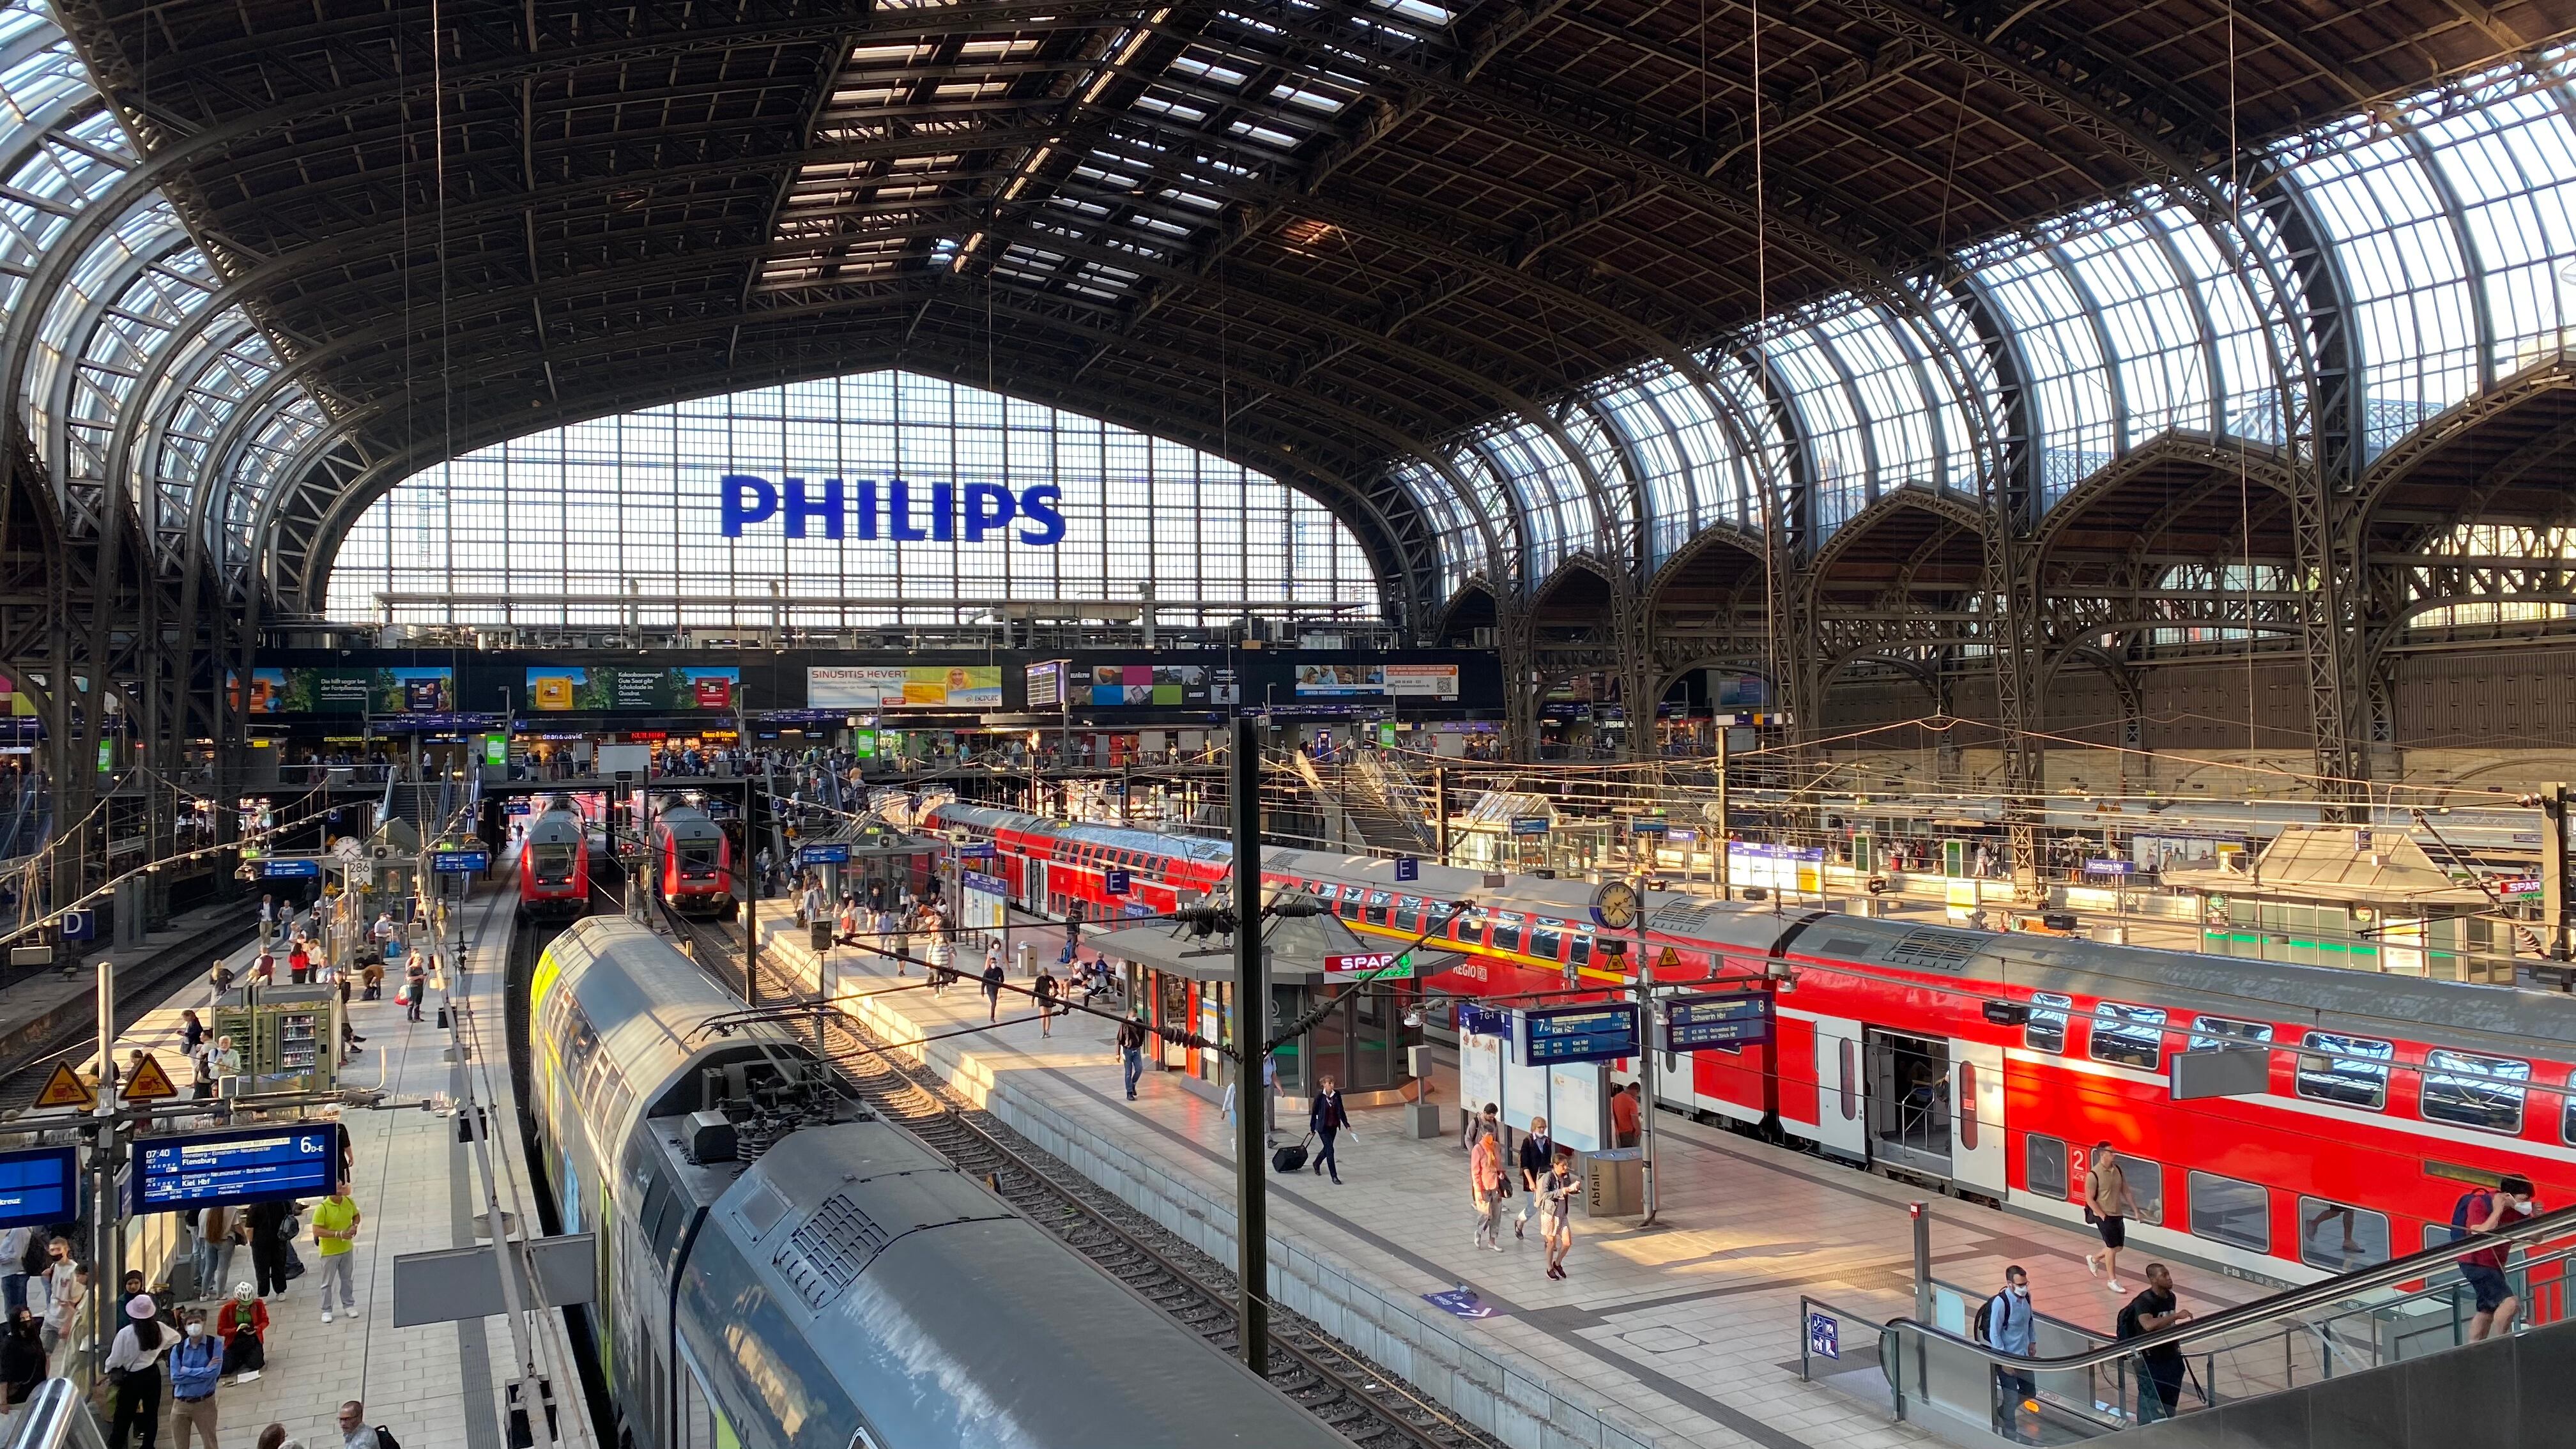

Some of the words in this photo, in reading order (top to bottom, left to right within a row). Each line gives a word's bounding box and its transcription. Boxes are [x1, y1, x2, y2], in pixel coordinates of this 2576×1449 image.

[721, 475, 1066, 546] PHILIPS
[773, 800, 779, 809] D
[329, 811, 337, 820] C
[350, 863, 369, 873] 286
[1400, 860, 1410, 877] E
[2089, 862, 2113, 871] Hamburg
[1110, 873, 1121, 891] E
[2509, 882, 2540, 892] SPAR
[64, 912, 82, 933] D
[1341, 955, 1394, 970] SPAR
[1453, 963, 1476, 978] REGIO
[1478, 968, 1487, 979] DB
[1561, 981, 1565, 990] 1
[1758, 1000, 1765, 1012] 8
[1691, 1013, 1716, 1022] Schwerin
[1538, 1019, 1545, 1032] 7
[240, 1145, 272, 1154] Neumünster
[300, 1137, 312, 1153] 6
[311, 1145, 324, 1153] D-E
[146, 1149, 170, 1158] 07:40
[182, 1157, 217, 1167] Flensburg
[2073, 1151, 2083, 1170] 2
[182, 1172, 206, 1181] Elmshorn
[1591, 1174, 1600, 1207] Abfall
[2223, 1266, 2240, 1277] D-DB
